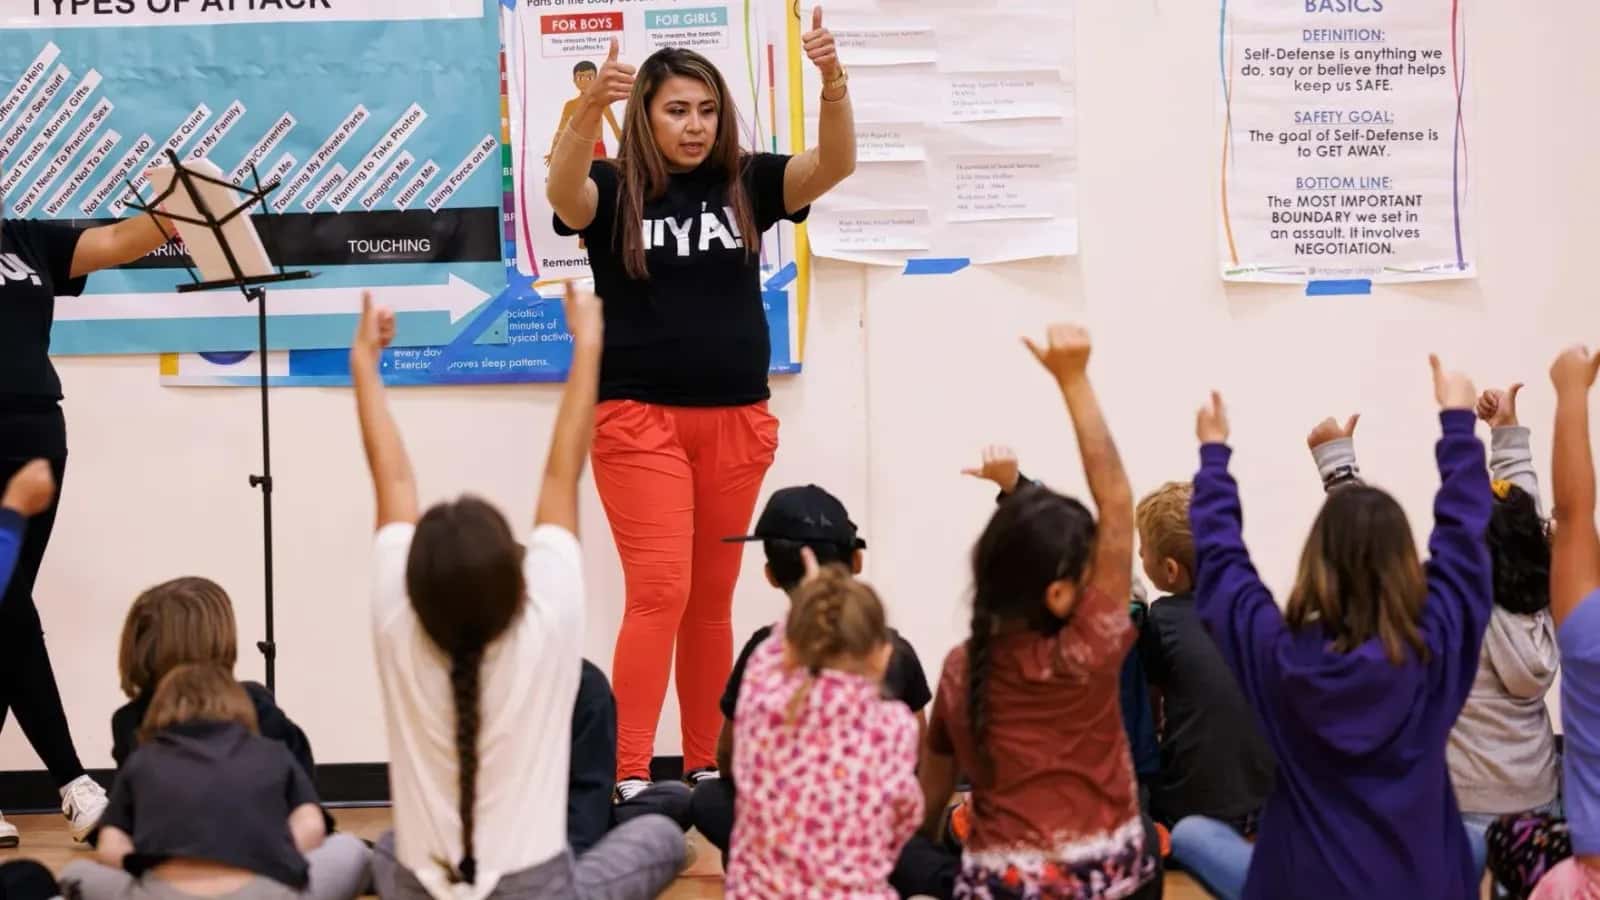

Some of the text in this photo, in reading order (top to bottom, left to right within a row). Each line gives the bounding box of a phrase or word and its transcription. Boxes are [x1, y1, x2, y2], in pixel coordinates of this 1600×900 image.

[1305, 0, 1384, 13] BASICS
[552, 17, 613, 32] FOR BOYS
[655, 12, 718, 25] FOR GIRLS
[1303, 29, 1385, 43] DEFINITION:
[1244, 47, 1443, 62] Self-Defense is anything we
[16, 83, 28, 94] to
[24, 61, 45, 84] Help
[1241, 62, 1446, 79] do, say or believe that helps
[1294, 79, 1393, 93] keep us SAFE.
[6, 122, 27, 146] Body
[25, 112, 34, 123] or
[31, 95, 49, 113] Sex
[44, 73, 65, 96] Stuff
[1294, 110, 1394, 124] SAFETY GOAL:
[17, 141, 48, 169] Treats,
[42, 108, 73, 139] Money,
[68, 85, 90, 107] Gifts
[168, 134, 183, 149] Be
[181, 109, 205, 135] Quiet
[193, 105, 241, 159] Or My Family
[1249, 129, 1439, 144] The goal of Self-Defense is
[331, 110, 421, 206] Wanting to Take Photos
[1298, 145, 1391, 157] to GET AWAY.
[15, 105, 110, 214] Says I Need To Practice Sex
[272, 111, 364, 210] Touching My Private Parts
[277, 160, 293, 174] Me
[47, 138, 114, 214] Warned Not To Tell
[83, 139, 150, 215] Not Hearing My NO
[428, 139, 496, 208] Using Force on Me
[362, 158, 410, 208] Dragging Me
[397, 165, 435, 207] Hitting Me
[1296, 176, 1393, 190] BOTTOM LINE:
[305, 173, 342, 210] Grabbing
[1267, 194, 1423, 208] The MOST IMPORTANT
[1272, 210, 1419, 224] BOUNDARY we set in
[1270, 226, 1420, 240] an assault. It involves
[348, 239, 431, 252] TOUCHING
[1295, 242, 1396, 256] NEGOTIATION.
[509, 318, 557, 330] minutes of
[541, 332, 576, 344] activity
[394, 349, 420, 360] every
[482, 357, 506, 370] sleep
[509, 357, 549, 370] patterns.
